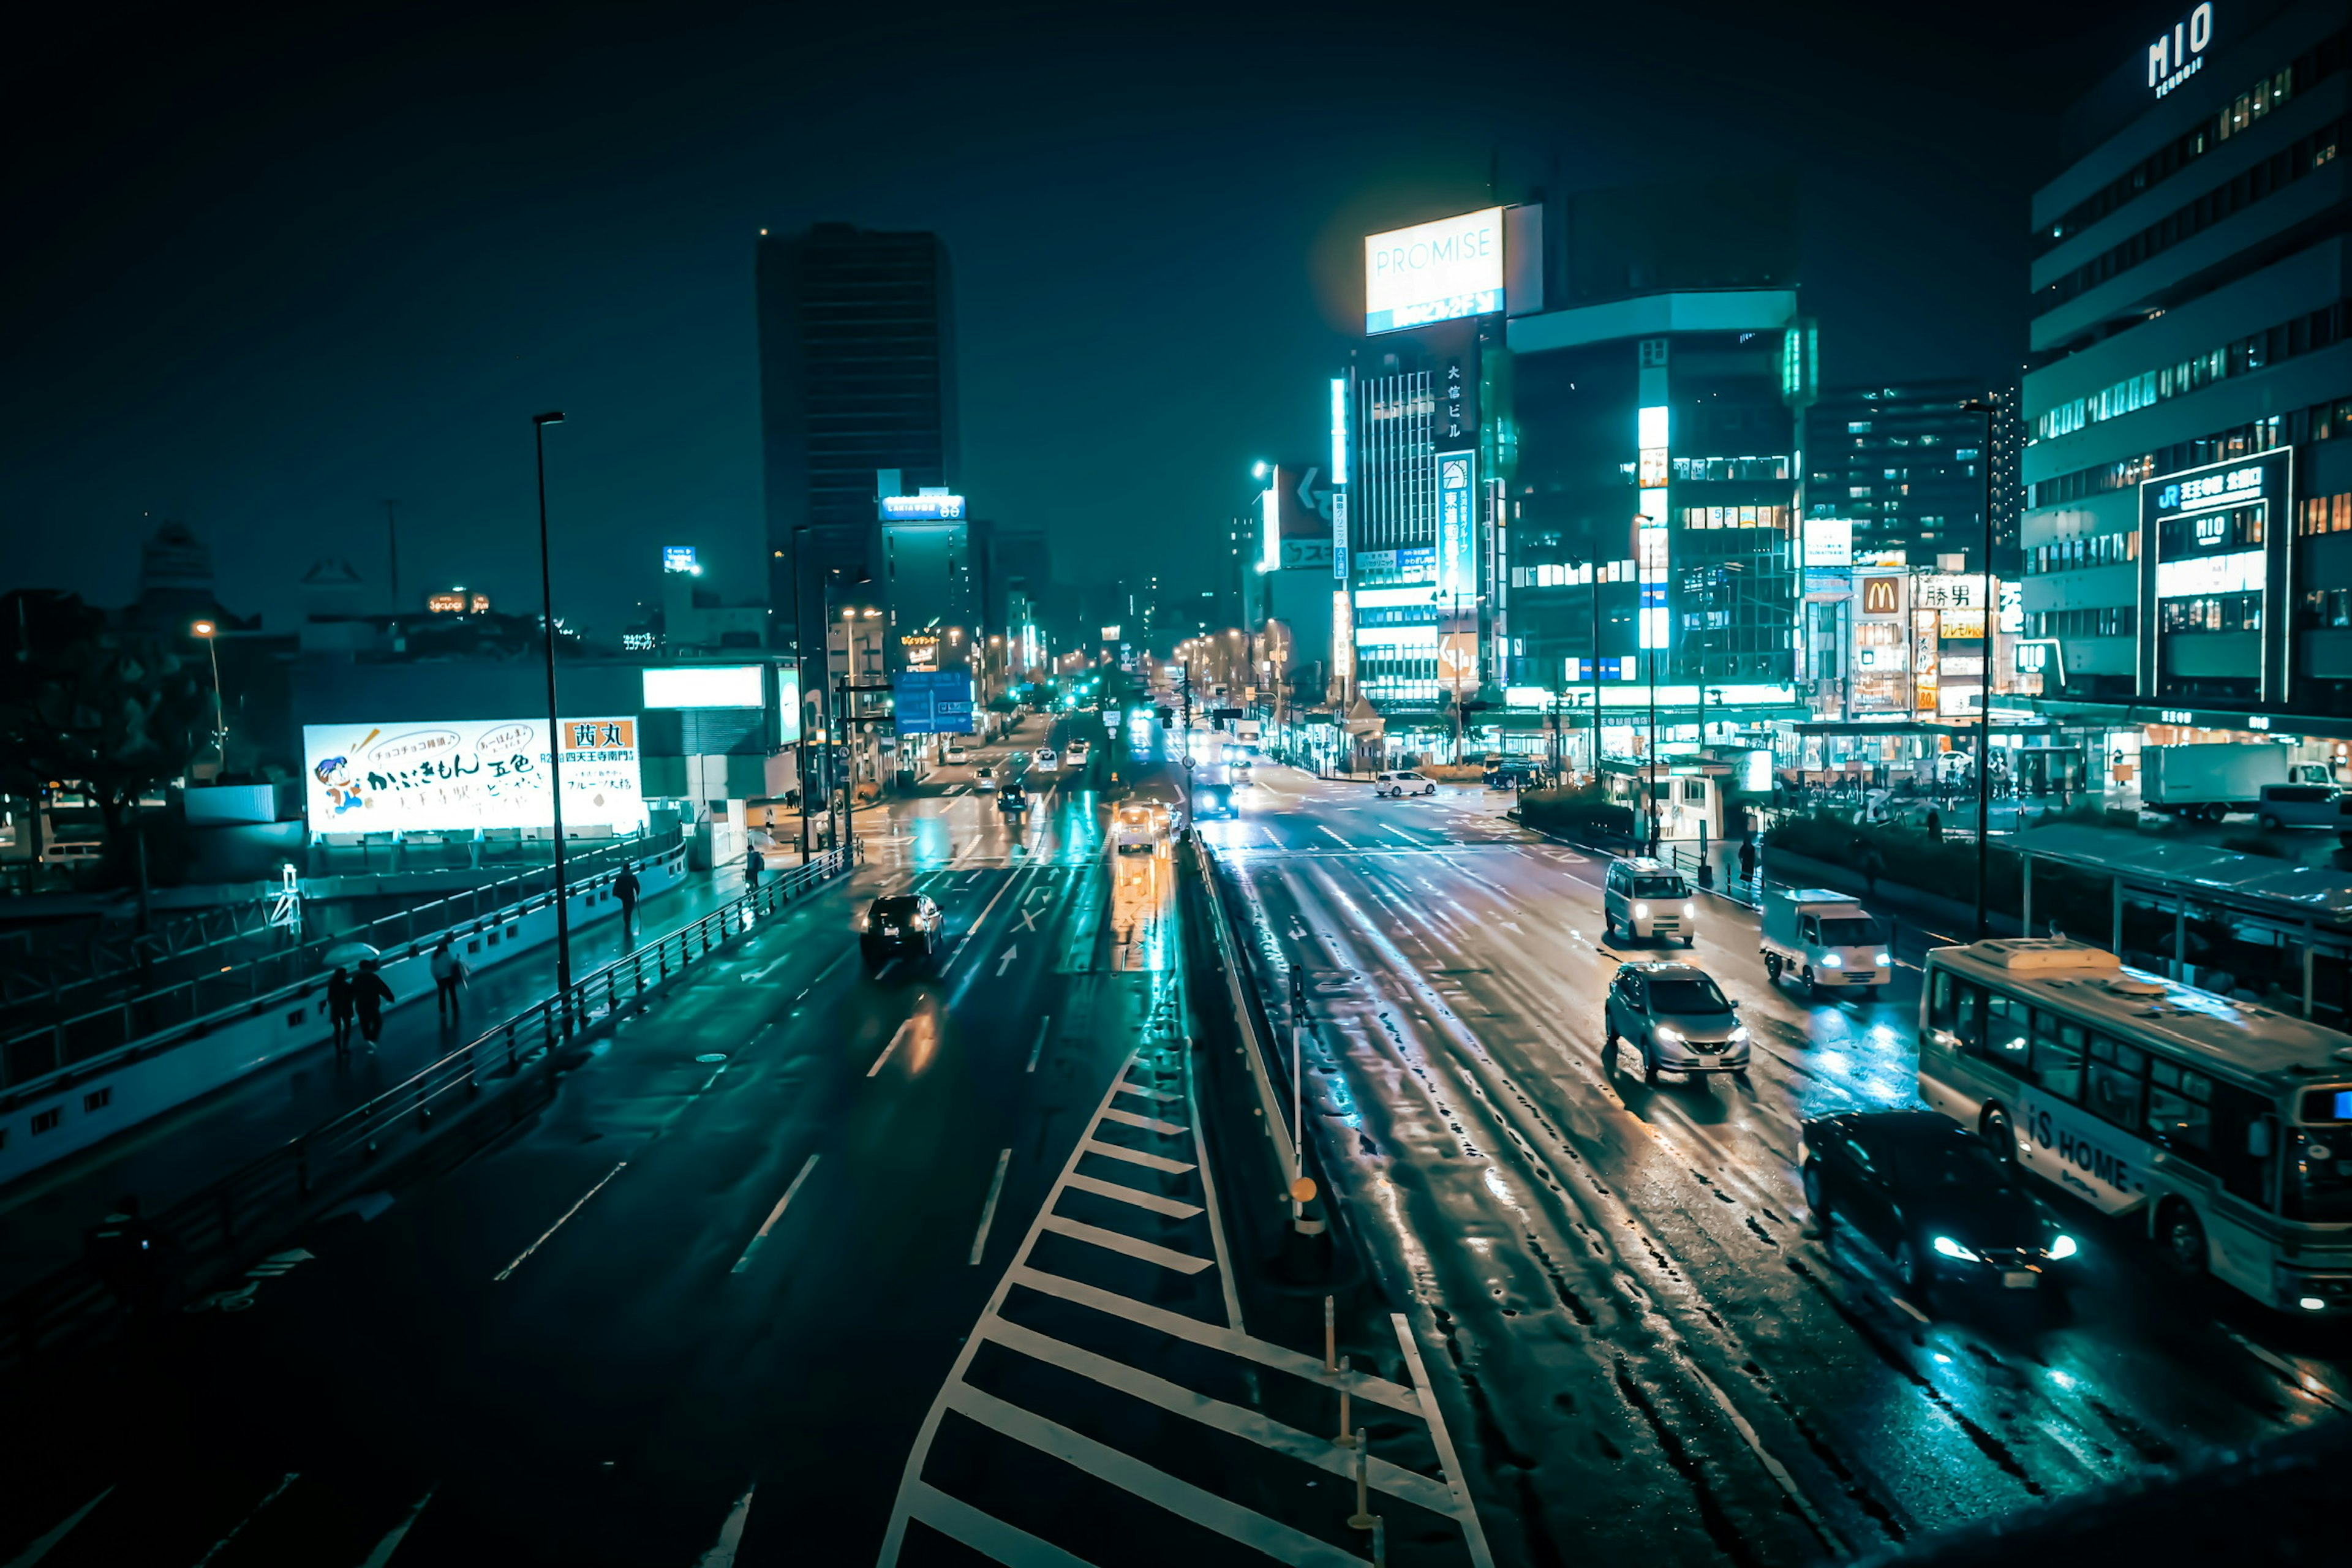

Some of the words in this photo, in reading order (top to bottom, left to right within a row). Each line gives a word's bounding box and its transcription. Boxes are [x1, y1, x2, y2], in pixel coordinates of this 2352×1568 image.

[2148, 1, 2213, 88] MIO
[1376, 228, 1490, 277] PROMISE
[1448, 366, 1461, 438] 大信ビル
[2158, 484, 2180, 509] JR
[2196, 516, 2225, 538] MIO
[1925, 584, 1970, 606] 勝男
[1591, 716, 1656, 726] 天王寺駅前商店
[573, 723, 625, 748] 茜丸
[487, 753, 534, 778] 五色
[566, 750, 628, 762] 四天王寺南門
[2059, 1129, 2129, 1194] HOME
